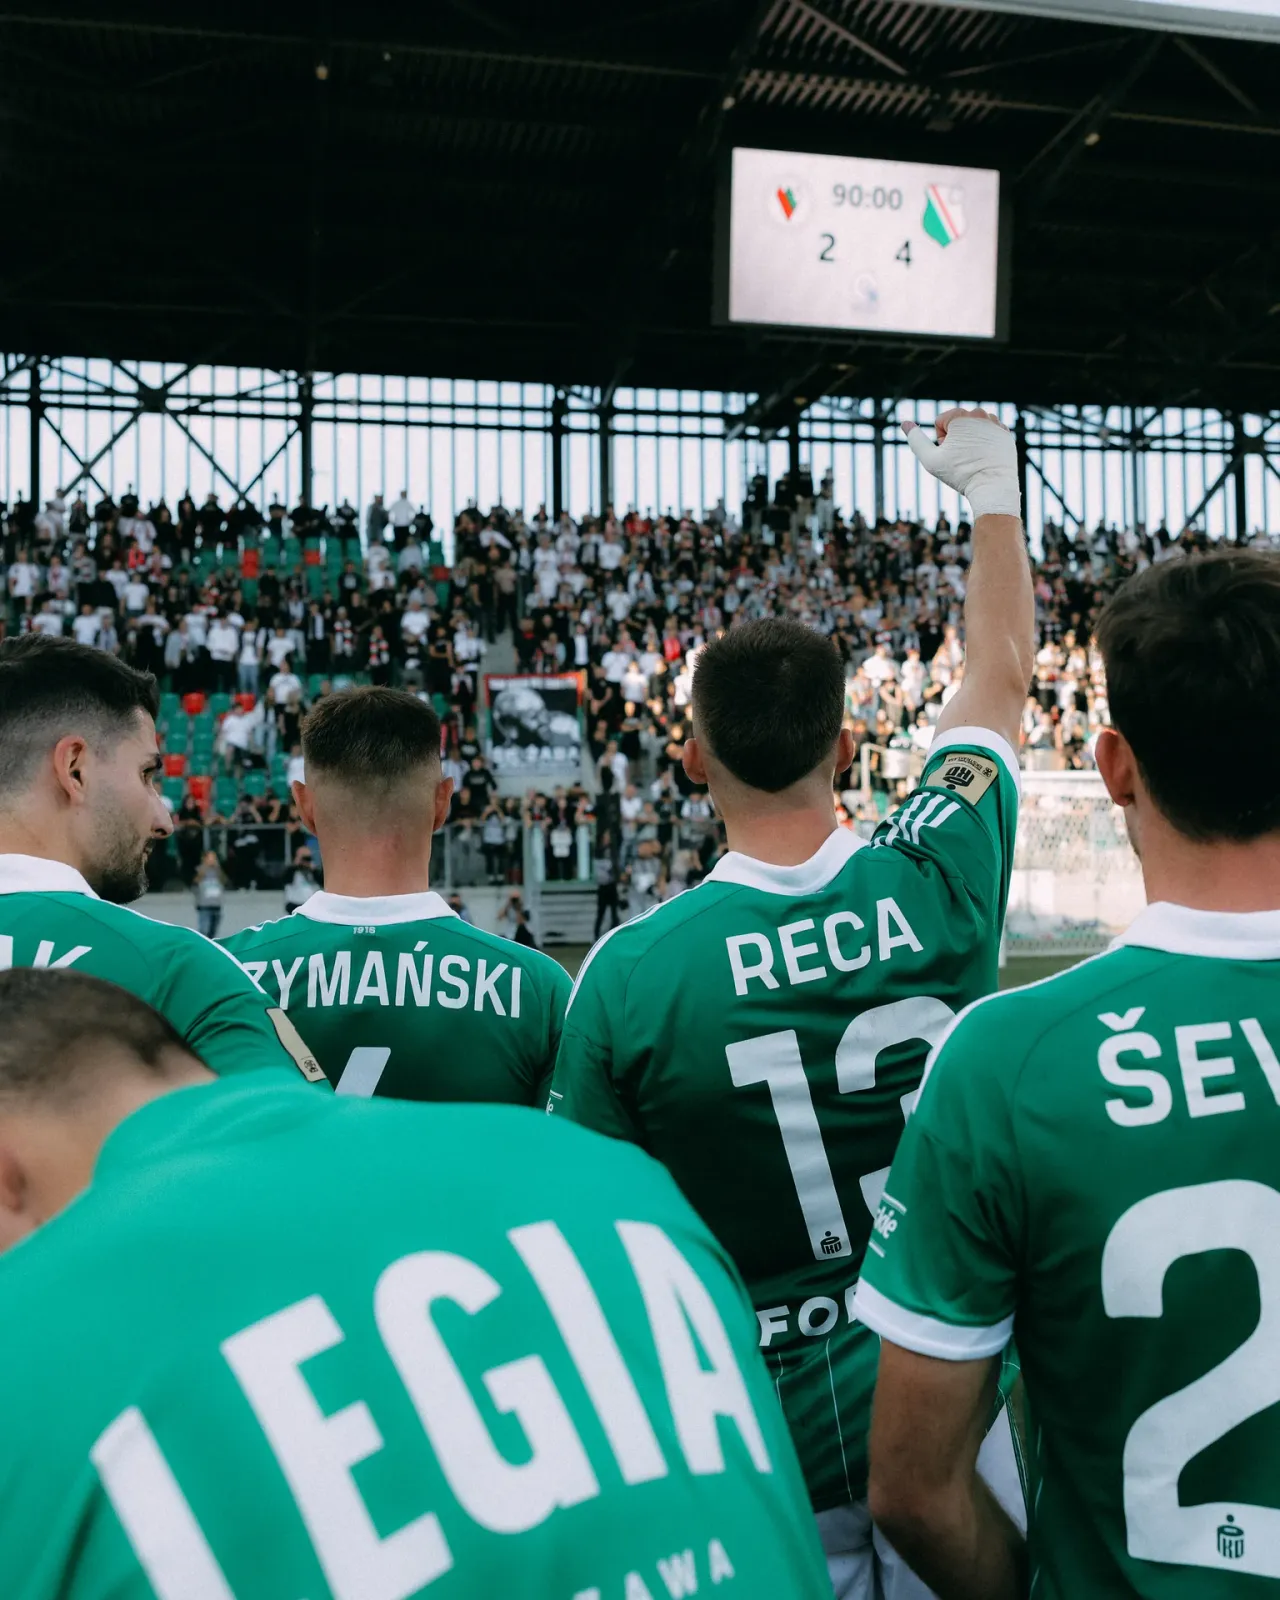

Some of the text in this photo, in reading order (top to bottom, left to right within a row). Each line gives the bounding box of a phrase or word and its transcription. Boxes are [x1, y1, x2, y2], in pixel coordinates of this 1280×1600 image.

[833, 183, 903, 211] 90:00
[819, 232, 912, 267] 2 4
[353, 926, 376, 935] 1916
[725, 897, 924, 996] RECA
[755, 1283, 860, 1347] FO
[90, 1219, 772, 1600] LEGIA
[1101, 1179, 1280, 1578] 2
